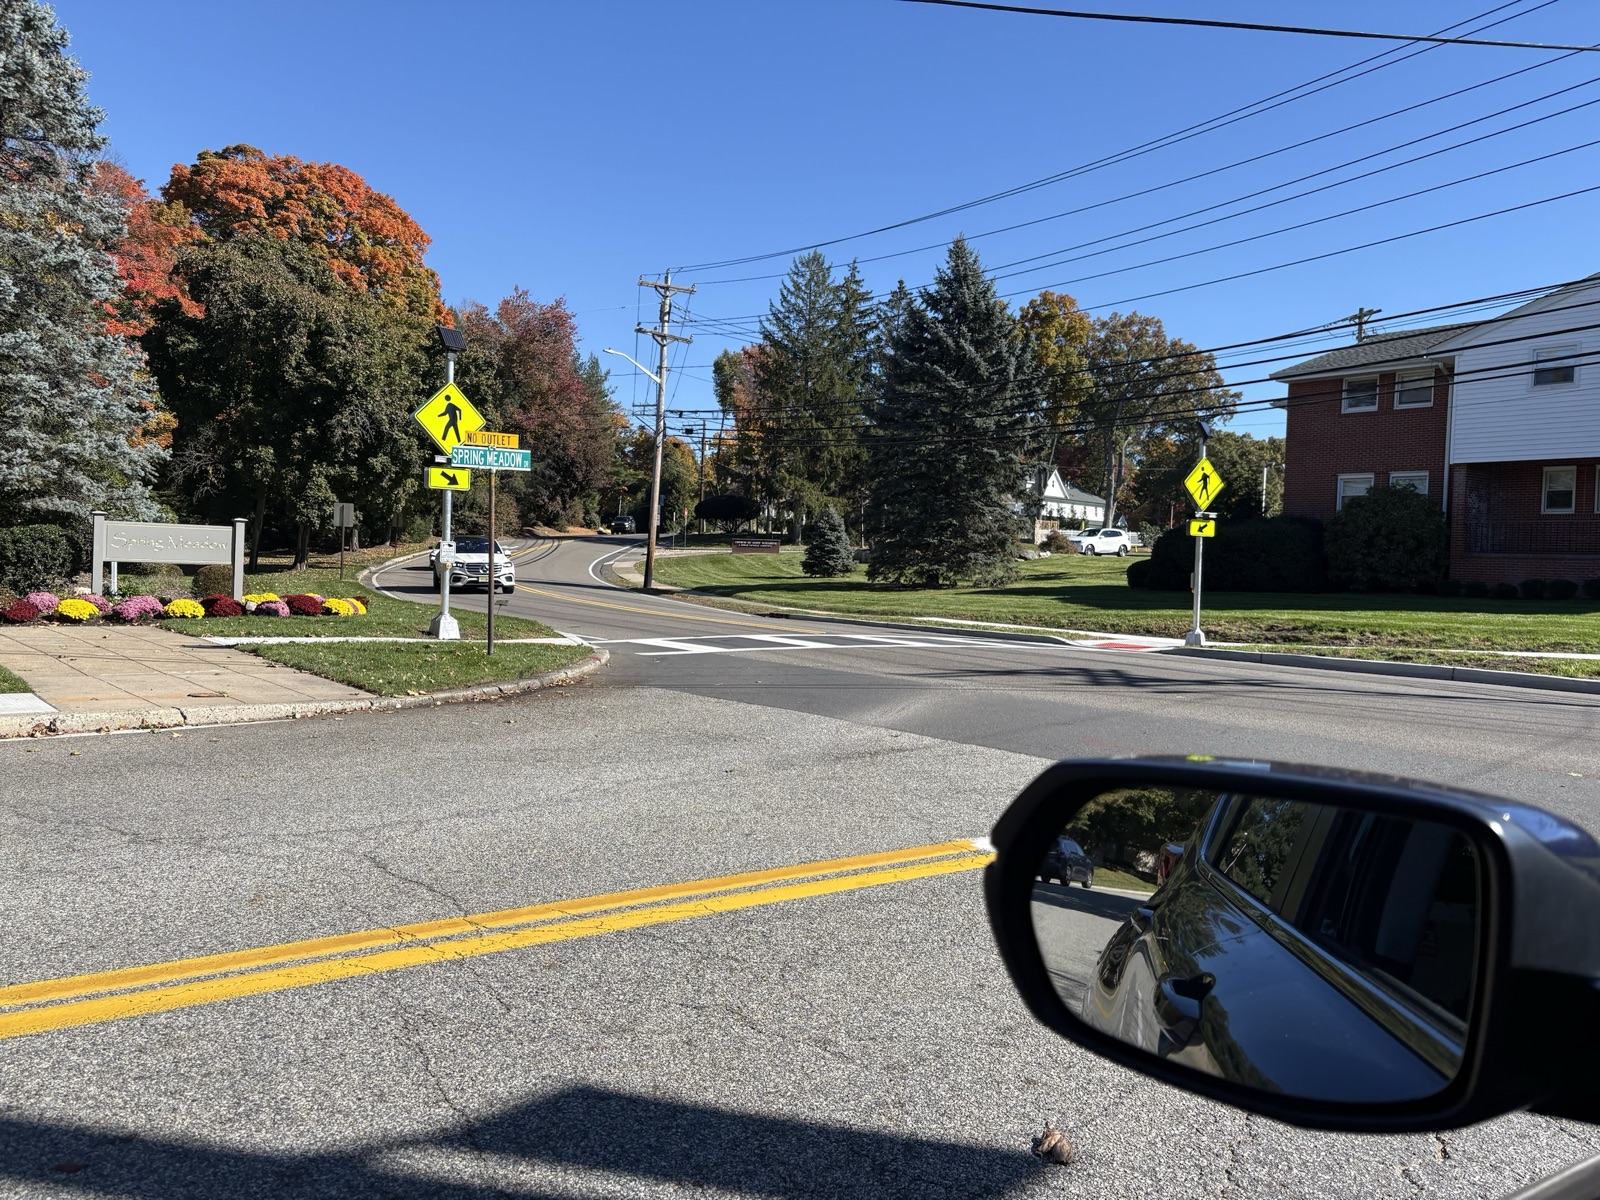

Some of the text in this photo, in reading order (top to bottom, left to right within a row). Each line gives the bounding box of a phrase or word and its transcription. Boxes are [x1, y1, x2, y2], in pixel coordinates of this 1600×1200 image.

[467, 433, 511, 446] NO OUTLET
[452, 448, 484, 465] SPRING
[486, 450, 523, 467] MEADOW
[110, 532, 229, 552] Spring Meadow
